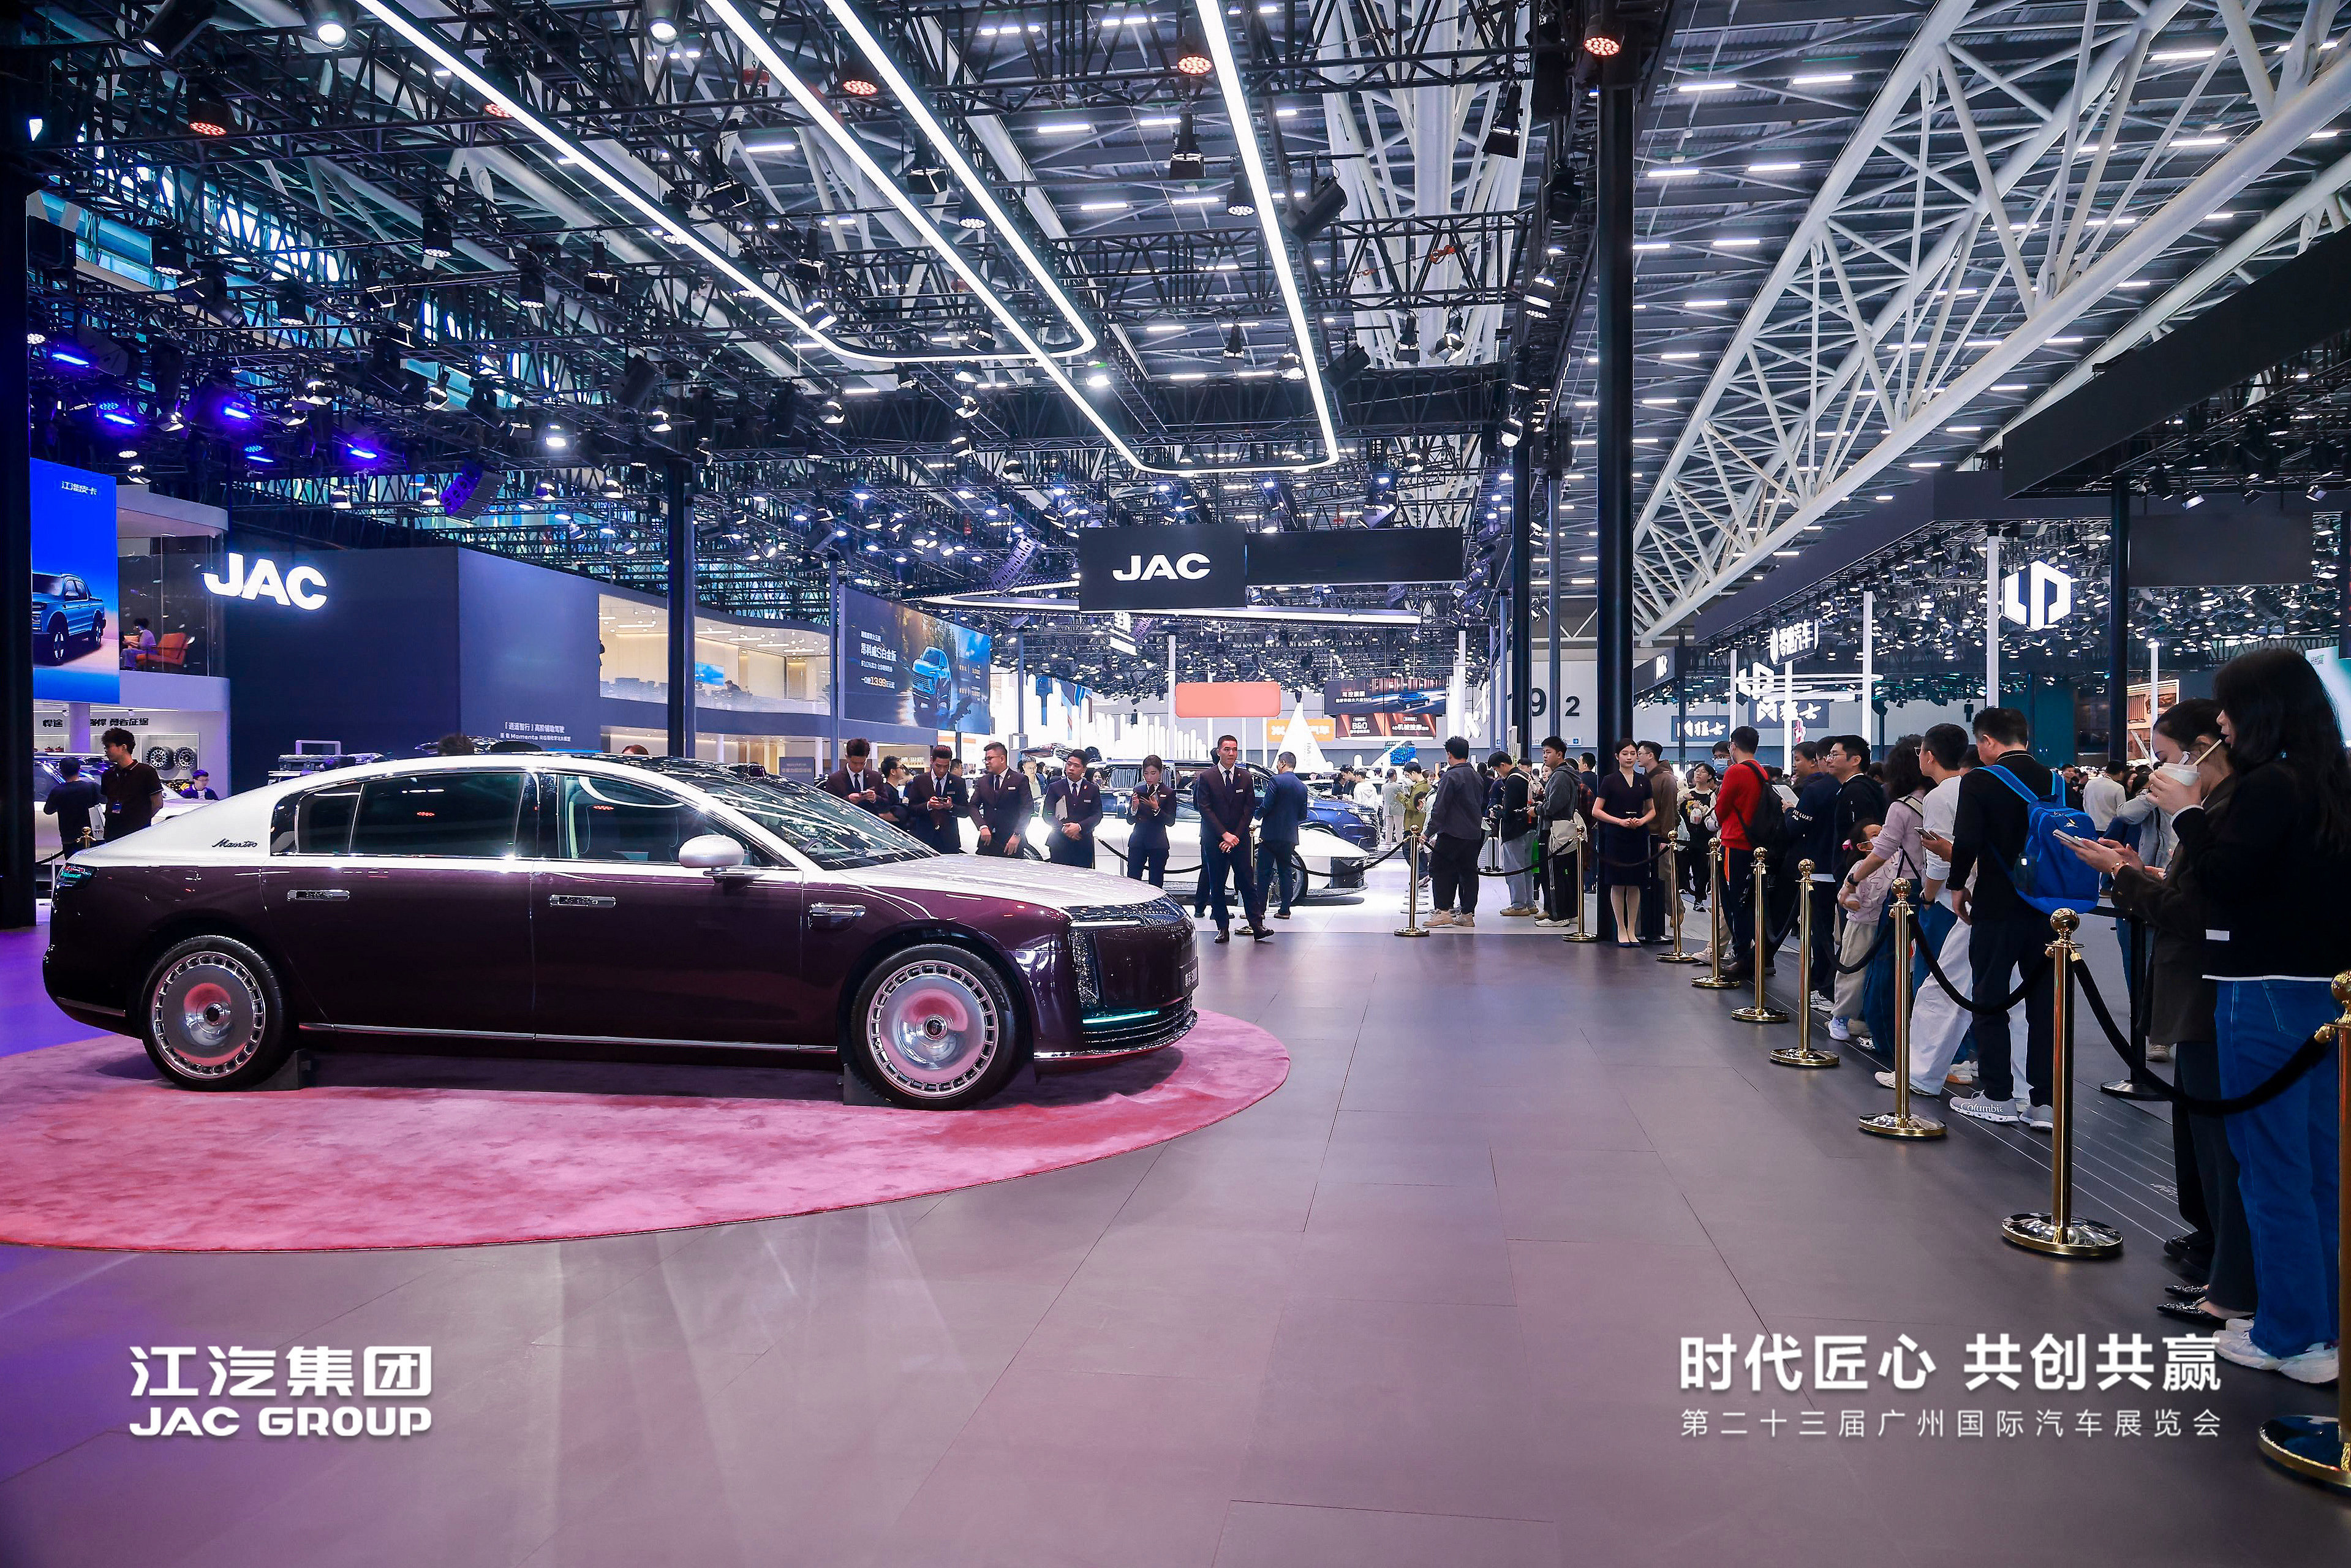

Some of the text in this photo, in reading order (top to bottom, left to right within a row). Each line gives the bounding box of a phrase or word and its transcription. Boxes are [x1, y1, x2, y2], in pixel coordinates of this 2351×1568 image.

[1112, 552, 1210, 581] JAC
[202, 552, 328, 610] JAC
[861, 643, 897, 662] 昂科威S白金版
[1565, 696, 1580, 716] 2
